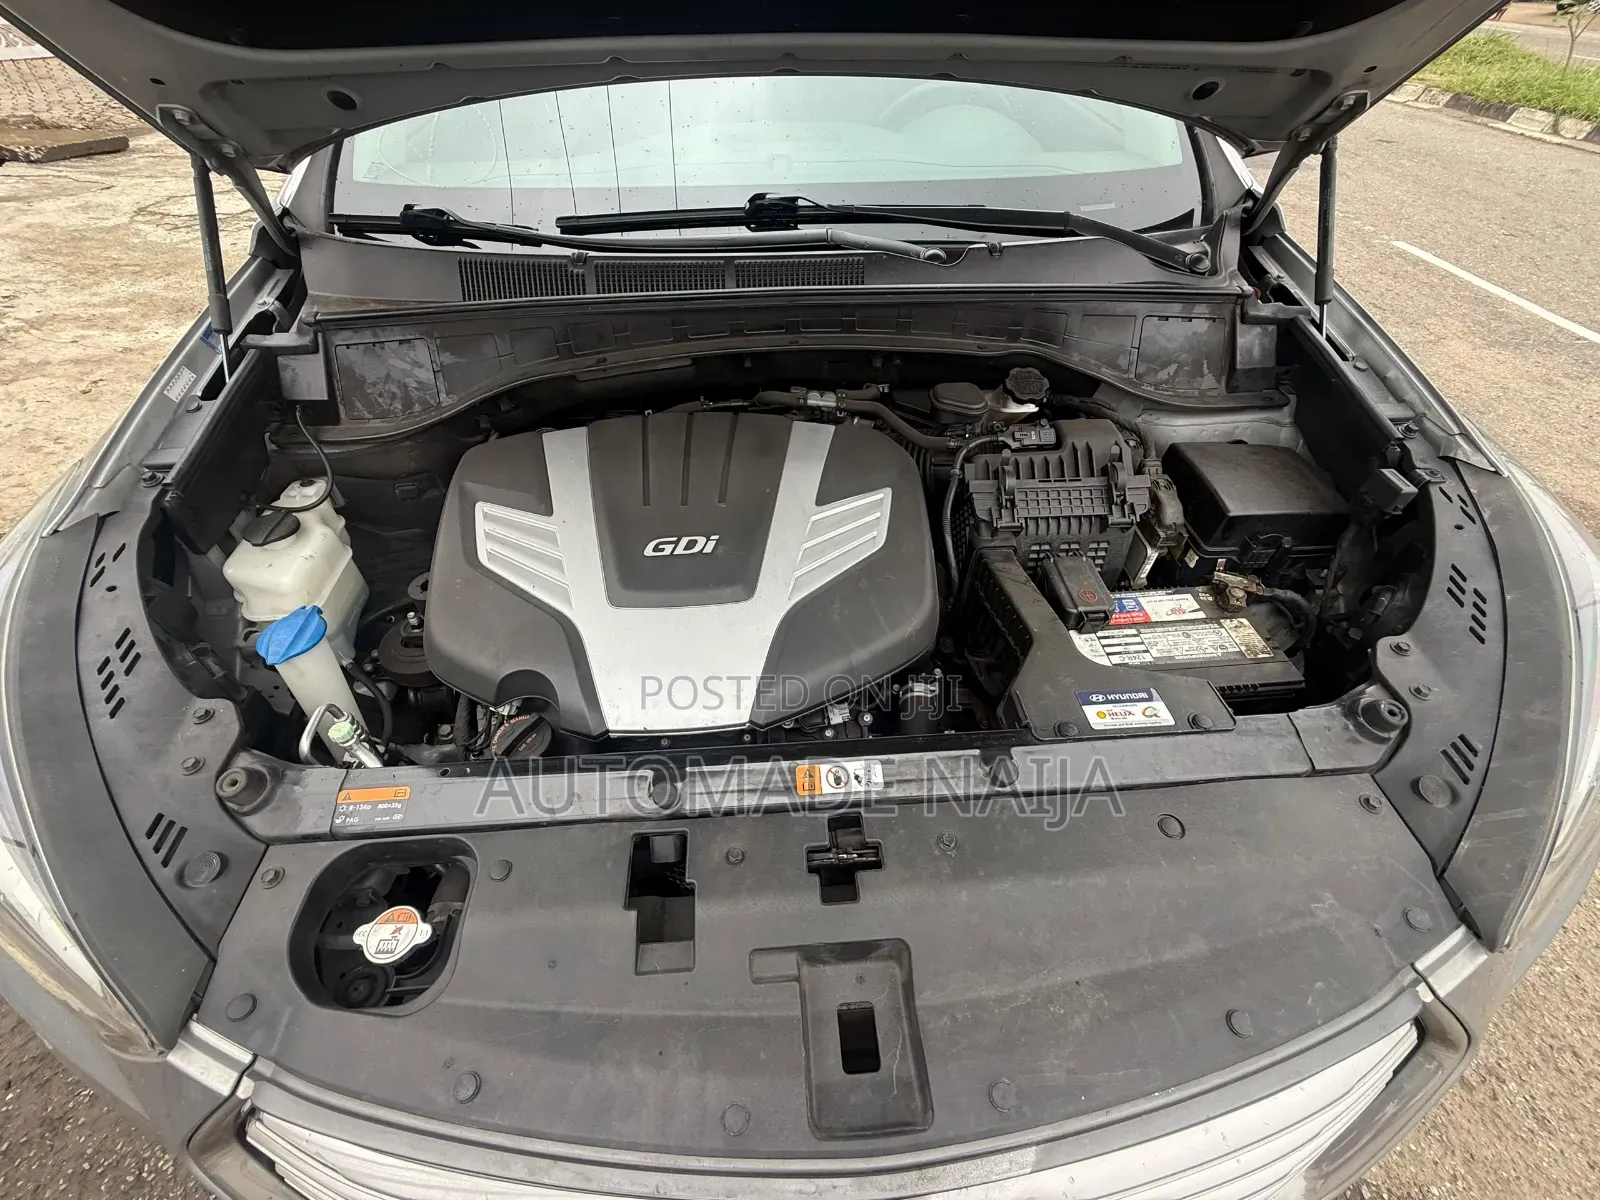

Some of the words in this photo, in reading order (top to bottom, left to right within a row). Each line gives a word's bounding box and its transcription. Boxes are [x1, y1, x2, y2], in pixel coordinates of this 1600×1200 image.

[643, 535, 720, 557] GDi
[1106, 692, 1149, 701] HYUNDAI
[1107, 709, 1136, 718] HELIX
[348, 803, 372, 811] R-134a
